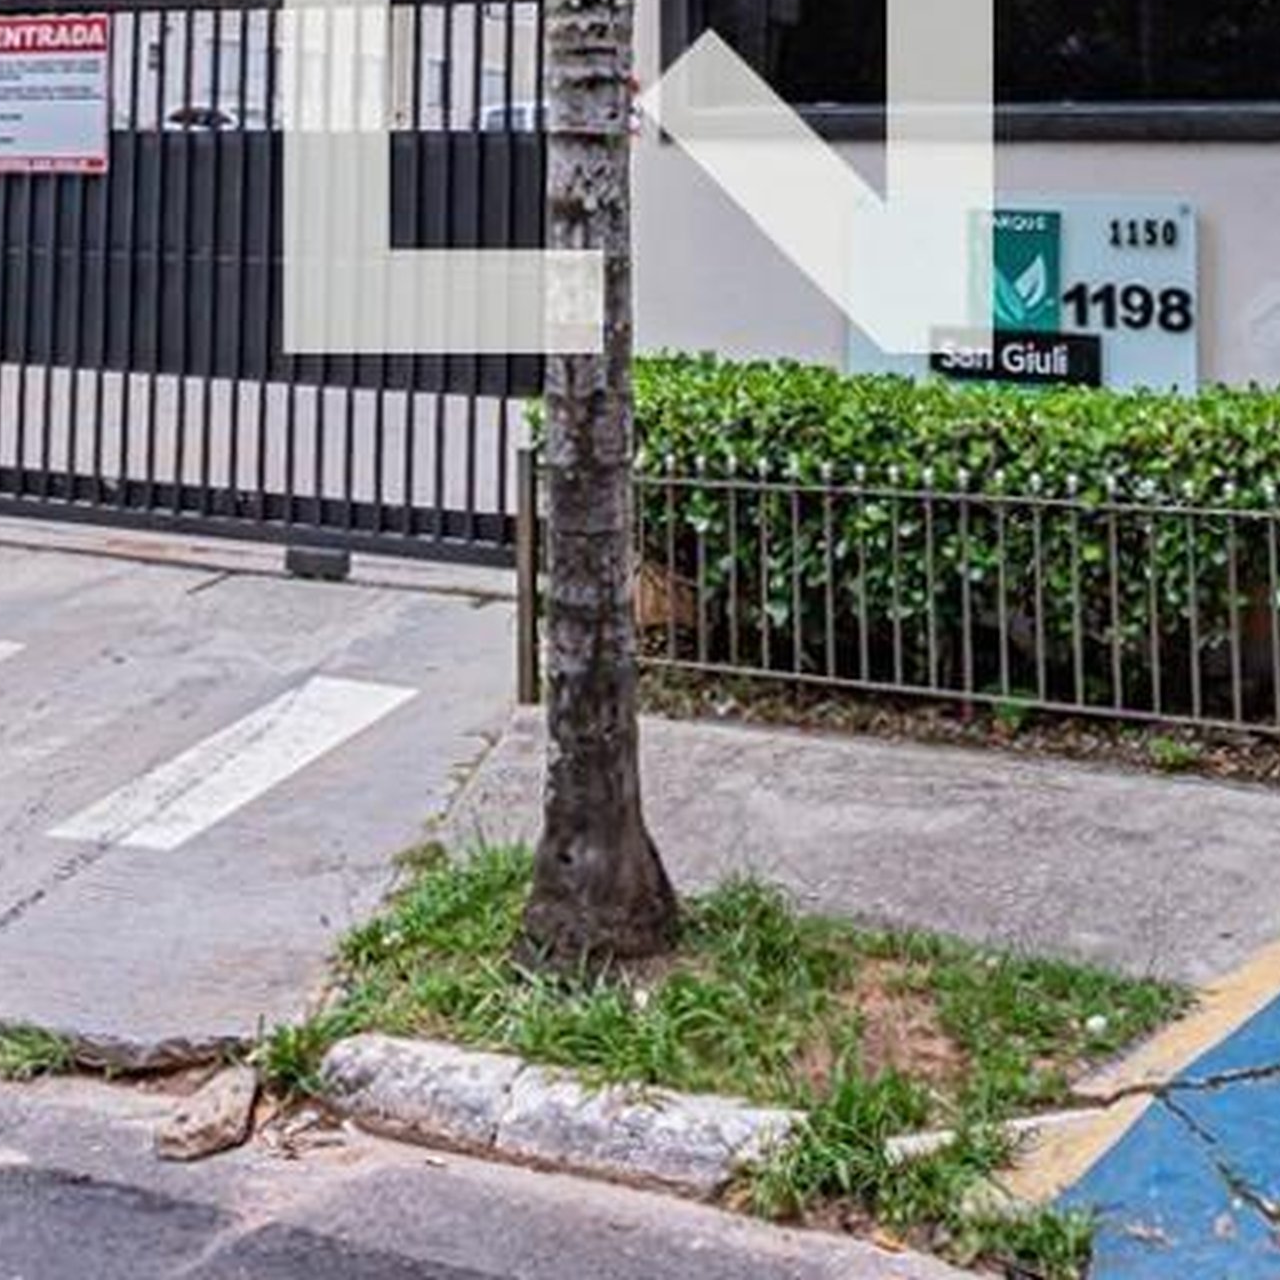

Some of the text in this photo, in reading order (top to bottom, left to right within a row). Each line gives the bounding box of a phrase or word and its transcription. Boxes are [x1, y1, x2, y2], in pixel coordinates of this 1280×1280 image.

[1108, 219, 1178, 248] 1150
[1062, 282, 1195, 333] 1198
[1001, 340, 1069, 376] Giuli
